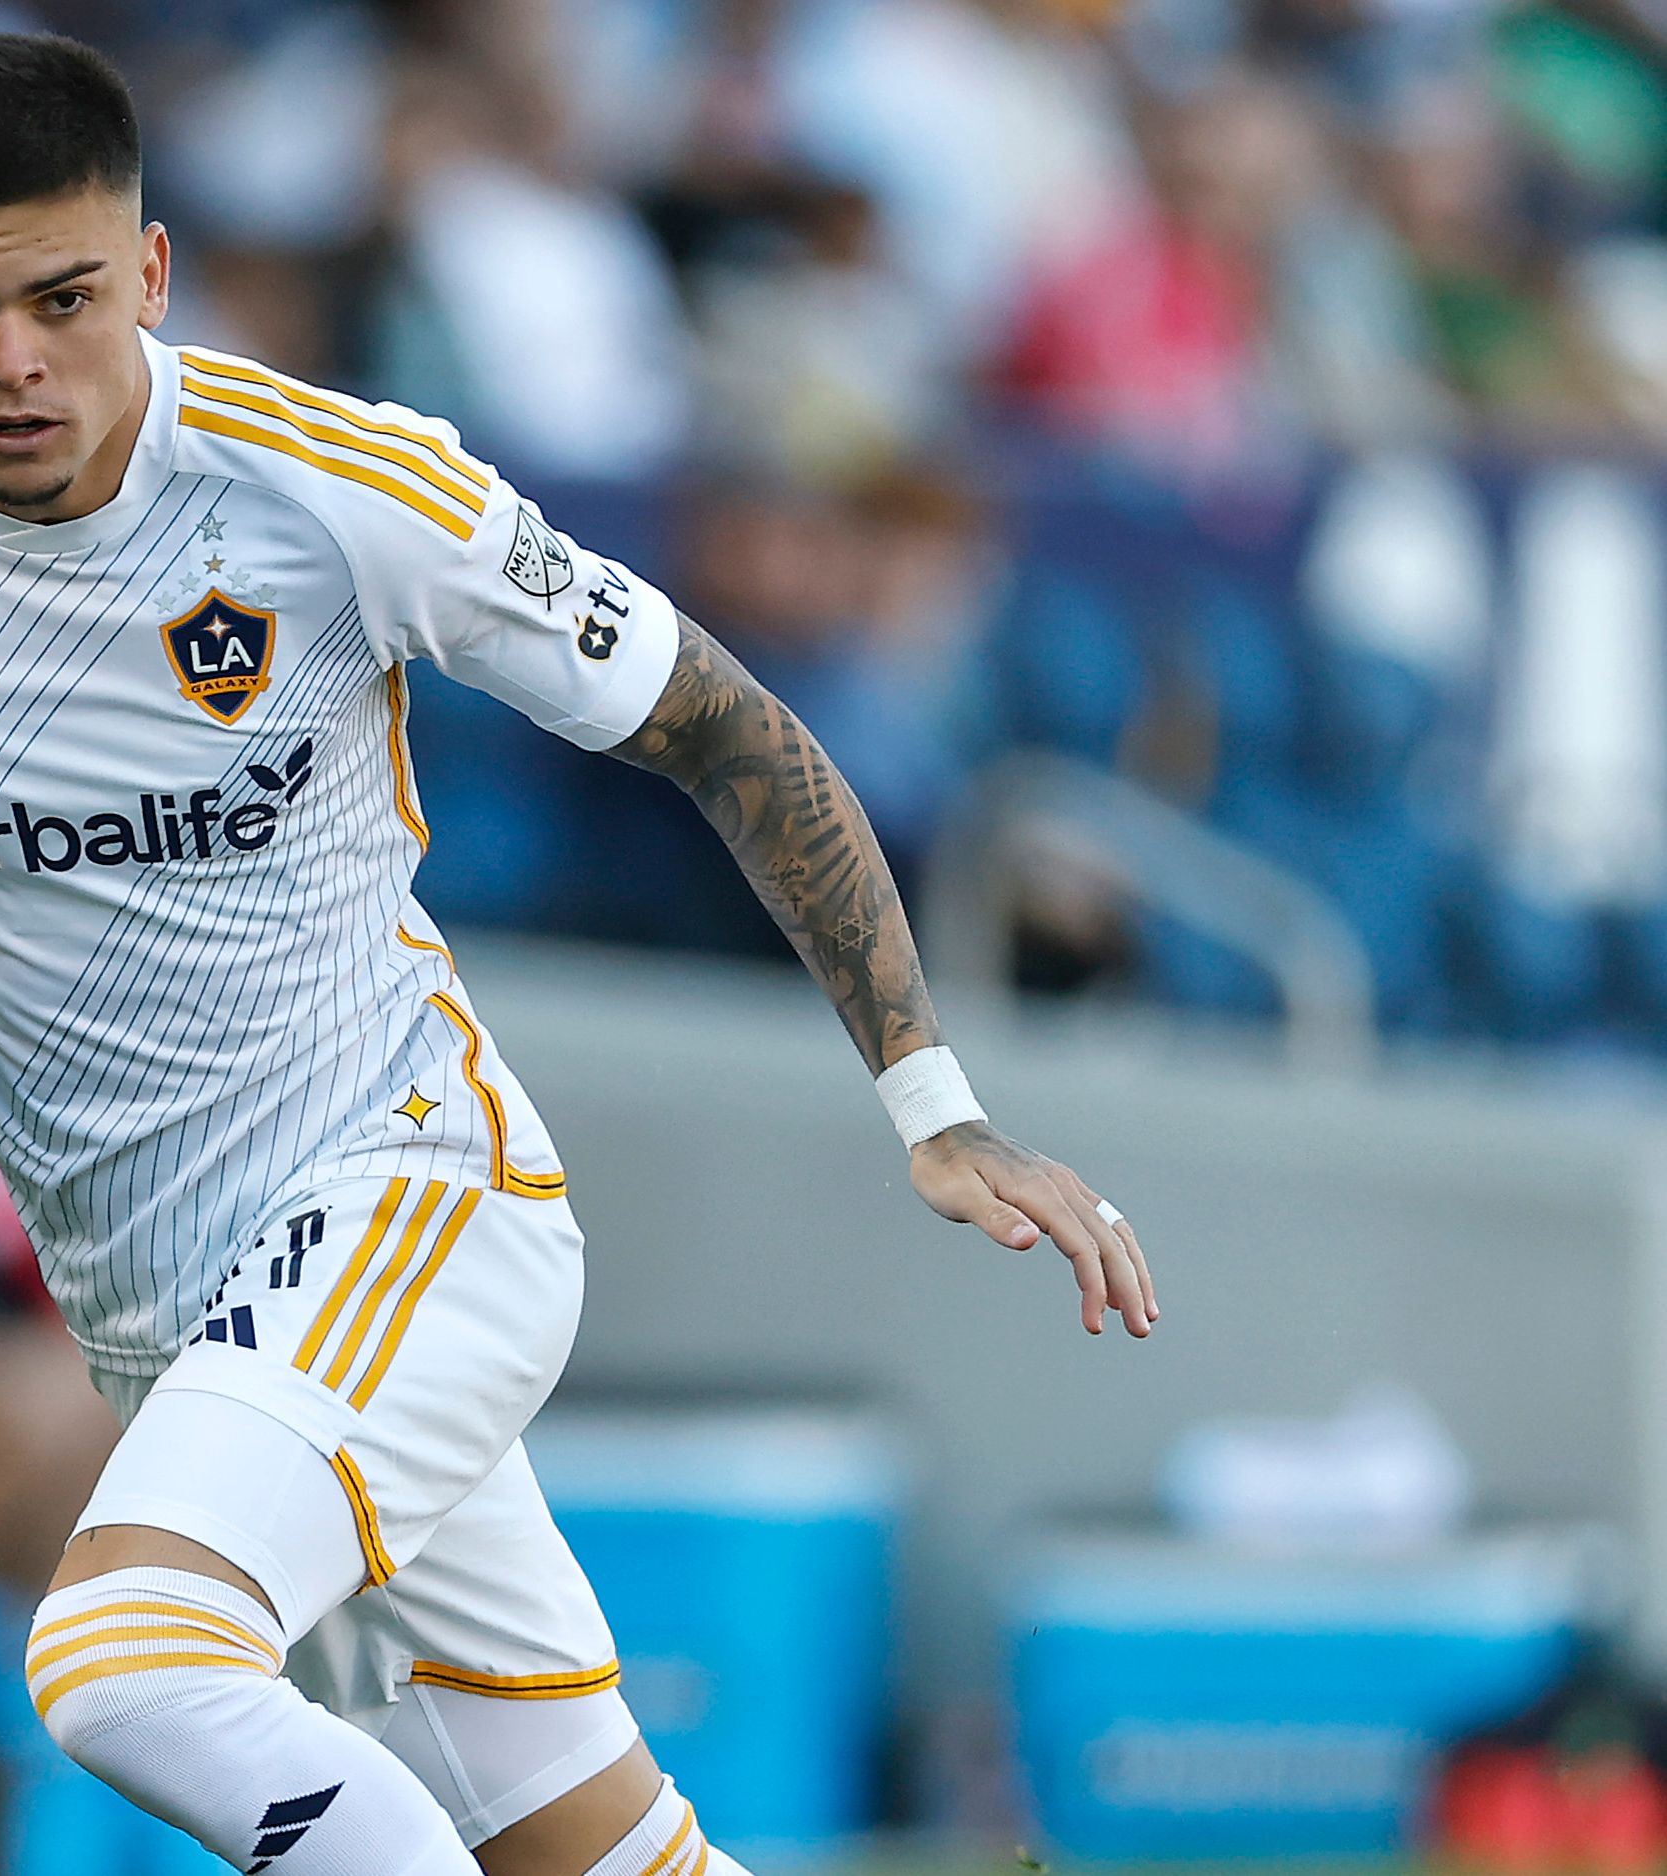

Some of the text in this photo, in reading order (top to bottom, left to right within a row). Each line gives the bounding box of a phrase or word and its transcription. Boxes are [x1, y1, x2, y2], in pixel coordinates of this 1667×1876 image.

[509, 535, 531, 577] MLS
[588, 563, 629, 618] tv
[190, 637, 254, 673] LA
[191, 678, 258, 693] GALAXY
